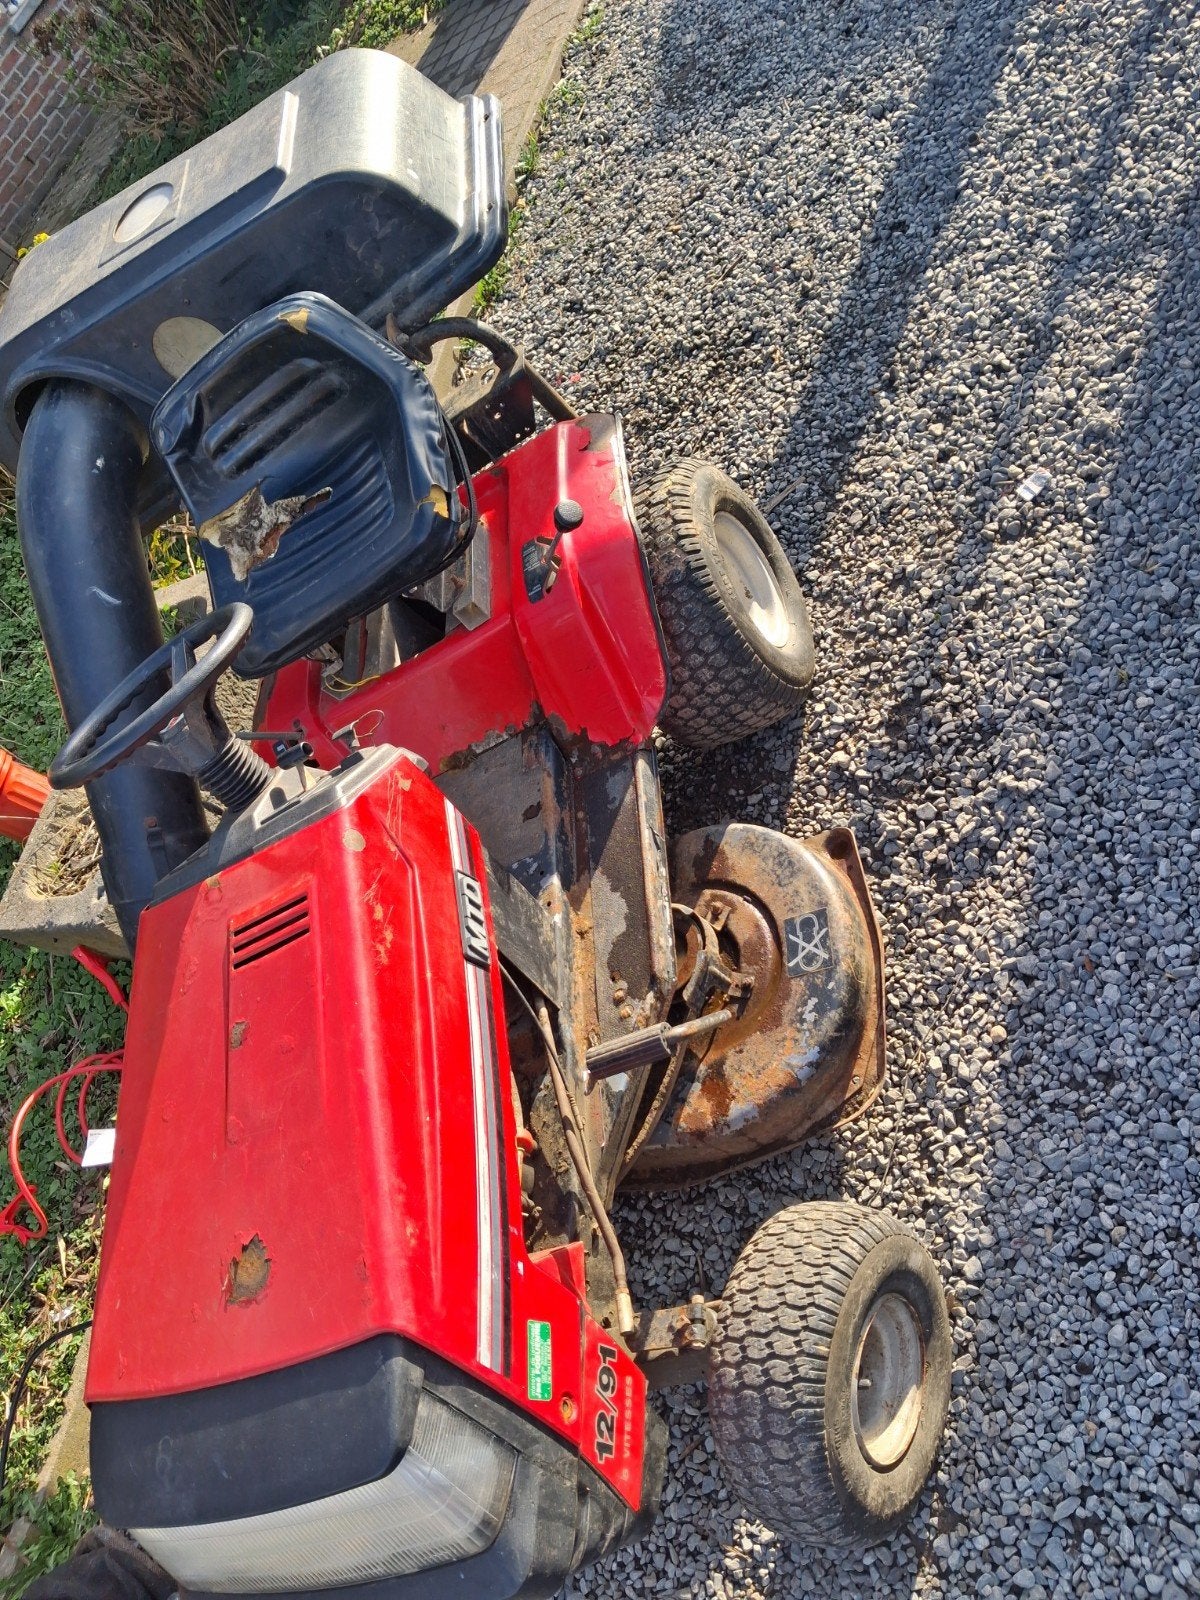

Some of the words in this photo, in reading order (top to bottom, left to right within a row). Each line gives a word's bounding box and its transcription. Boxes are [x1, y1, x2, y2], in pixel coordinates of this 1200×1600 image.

[463, 876, 490, 957] MTD
[595, 1343, 618, 1464] 12/91
[623, 1375, 633, 1458] VITESSES
